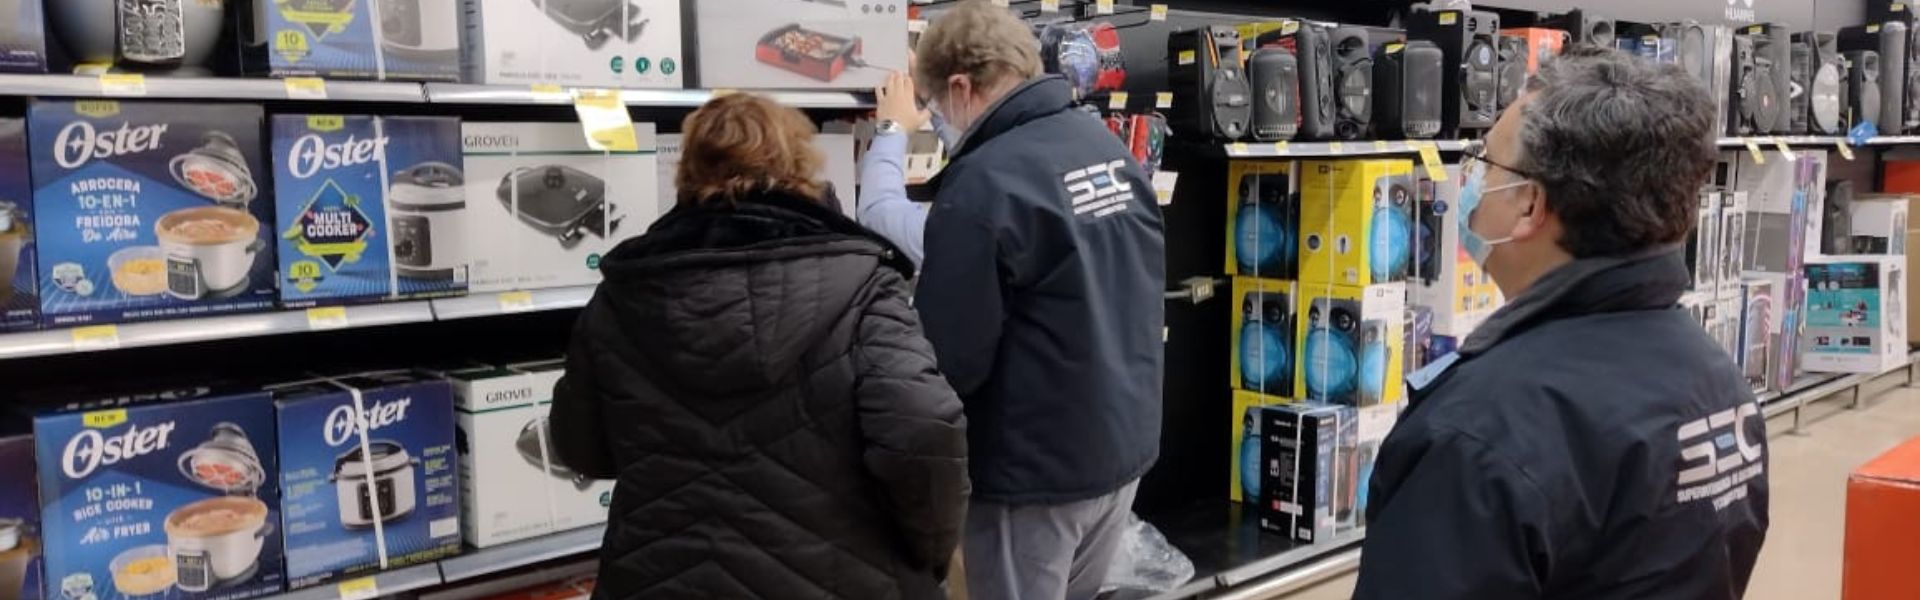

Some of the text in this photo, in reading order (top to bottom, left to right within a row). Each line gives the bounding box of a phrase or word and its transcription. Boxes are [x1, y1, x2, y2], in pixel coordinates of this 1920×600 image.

[54, 120, 168, 169] Oster
[288, 133, 390, 178] Oster
[71, 178, 140, 195] ARROCERA
[1064, 159, 1131, 205] SEC
[78, 193, 136, 210] 10-EN-1
[75, 214, 140, 229] FREIDORA
[306, 222, 358, 238] COOKER
[313, 211, 352, 226] MULTI
[323, 397, 412, 446] Oster
[62, 419, 176, 479] Oster
[1677, 401, 1762, 485] SEC
[73, 498, 153, 522] RICE COOKER
[114, 521, 151, 538] FRYER
